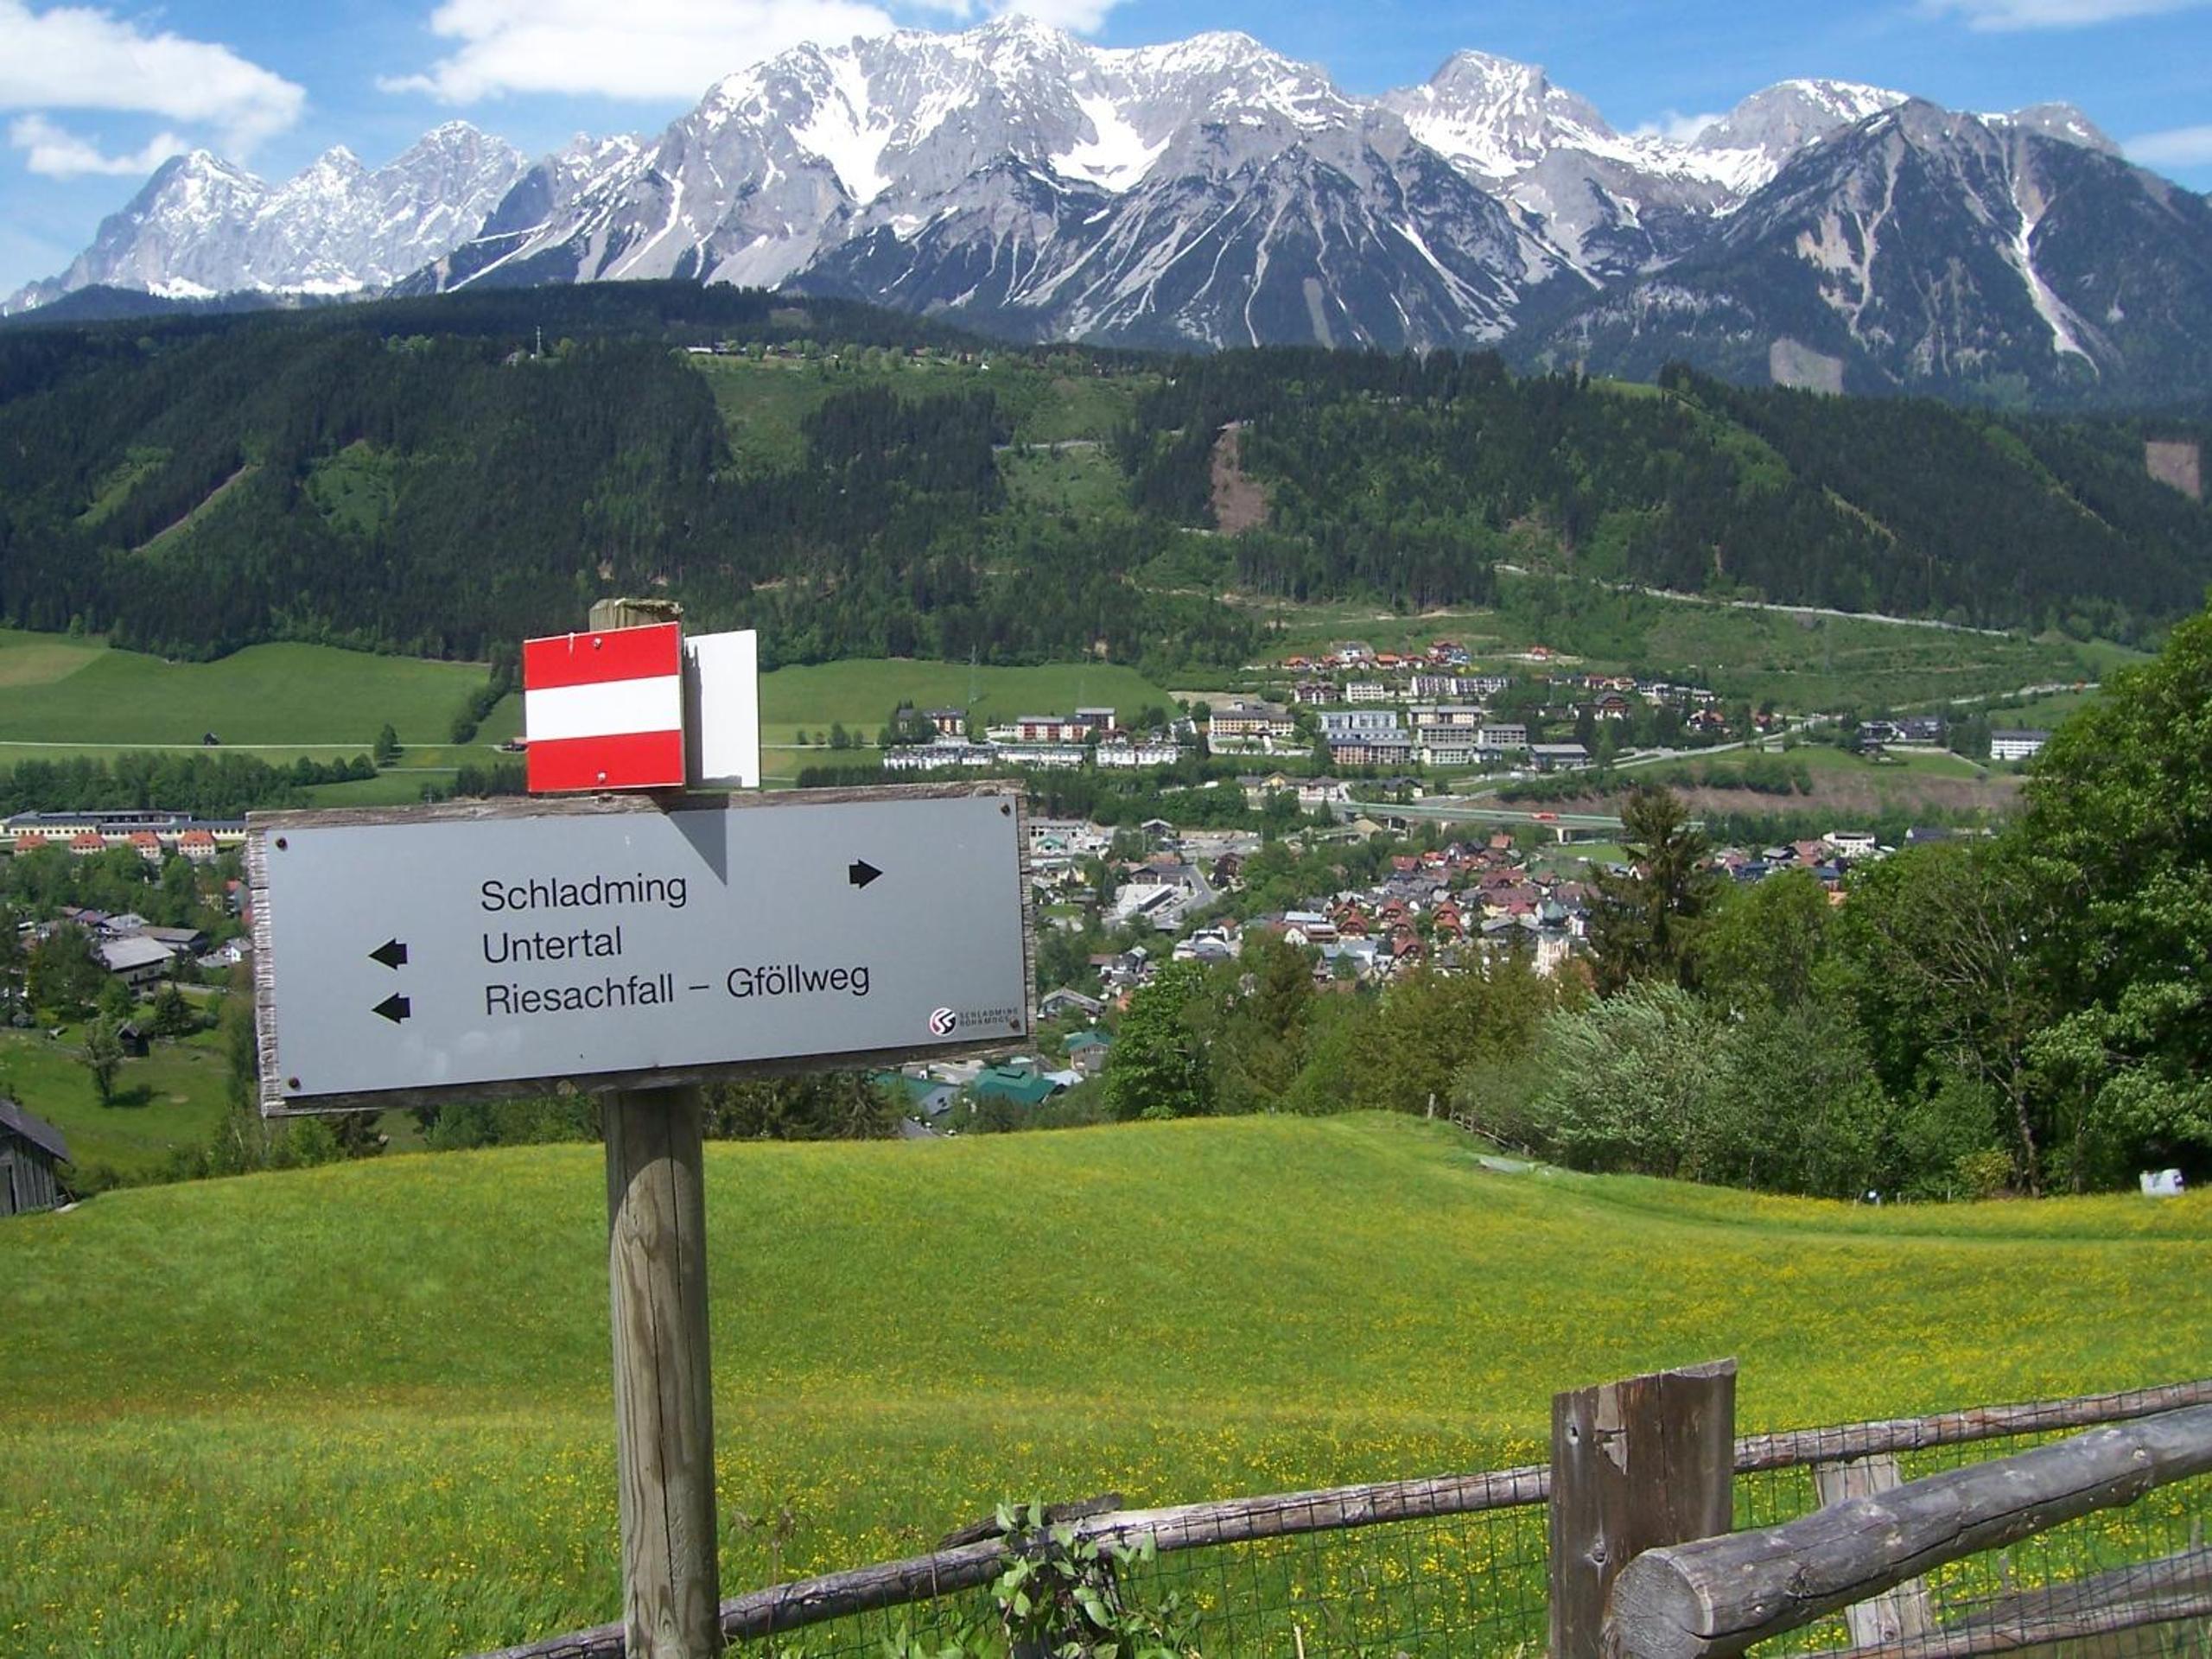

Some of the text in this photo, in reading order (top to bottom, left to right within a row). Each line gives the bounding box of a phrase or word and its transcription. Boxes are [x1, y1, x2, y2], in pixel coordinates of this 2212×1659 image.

[481, 872, 687, 912] Schladming
[483, 925, 623, 963] Untertal
[486, 972, 675, 1016] Riesachfall
[727, 963, 870, 998] Gföllweg
[959, 1007, 1018, 1019] SCHLADMING
